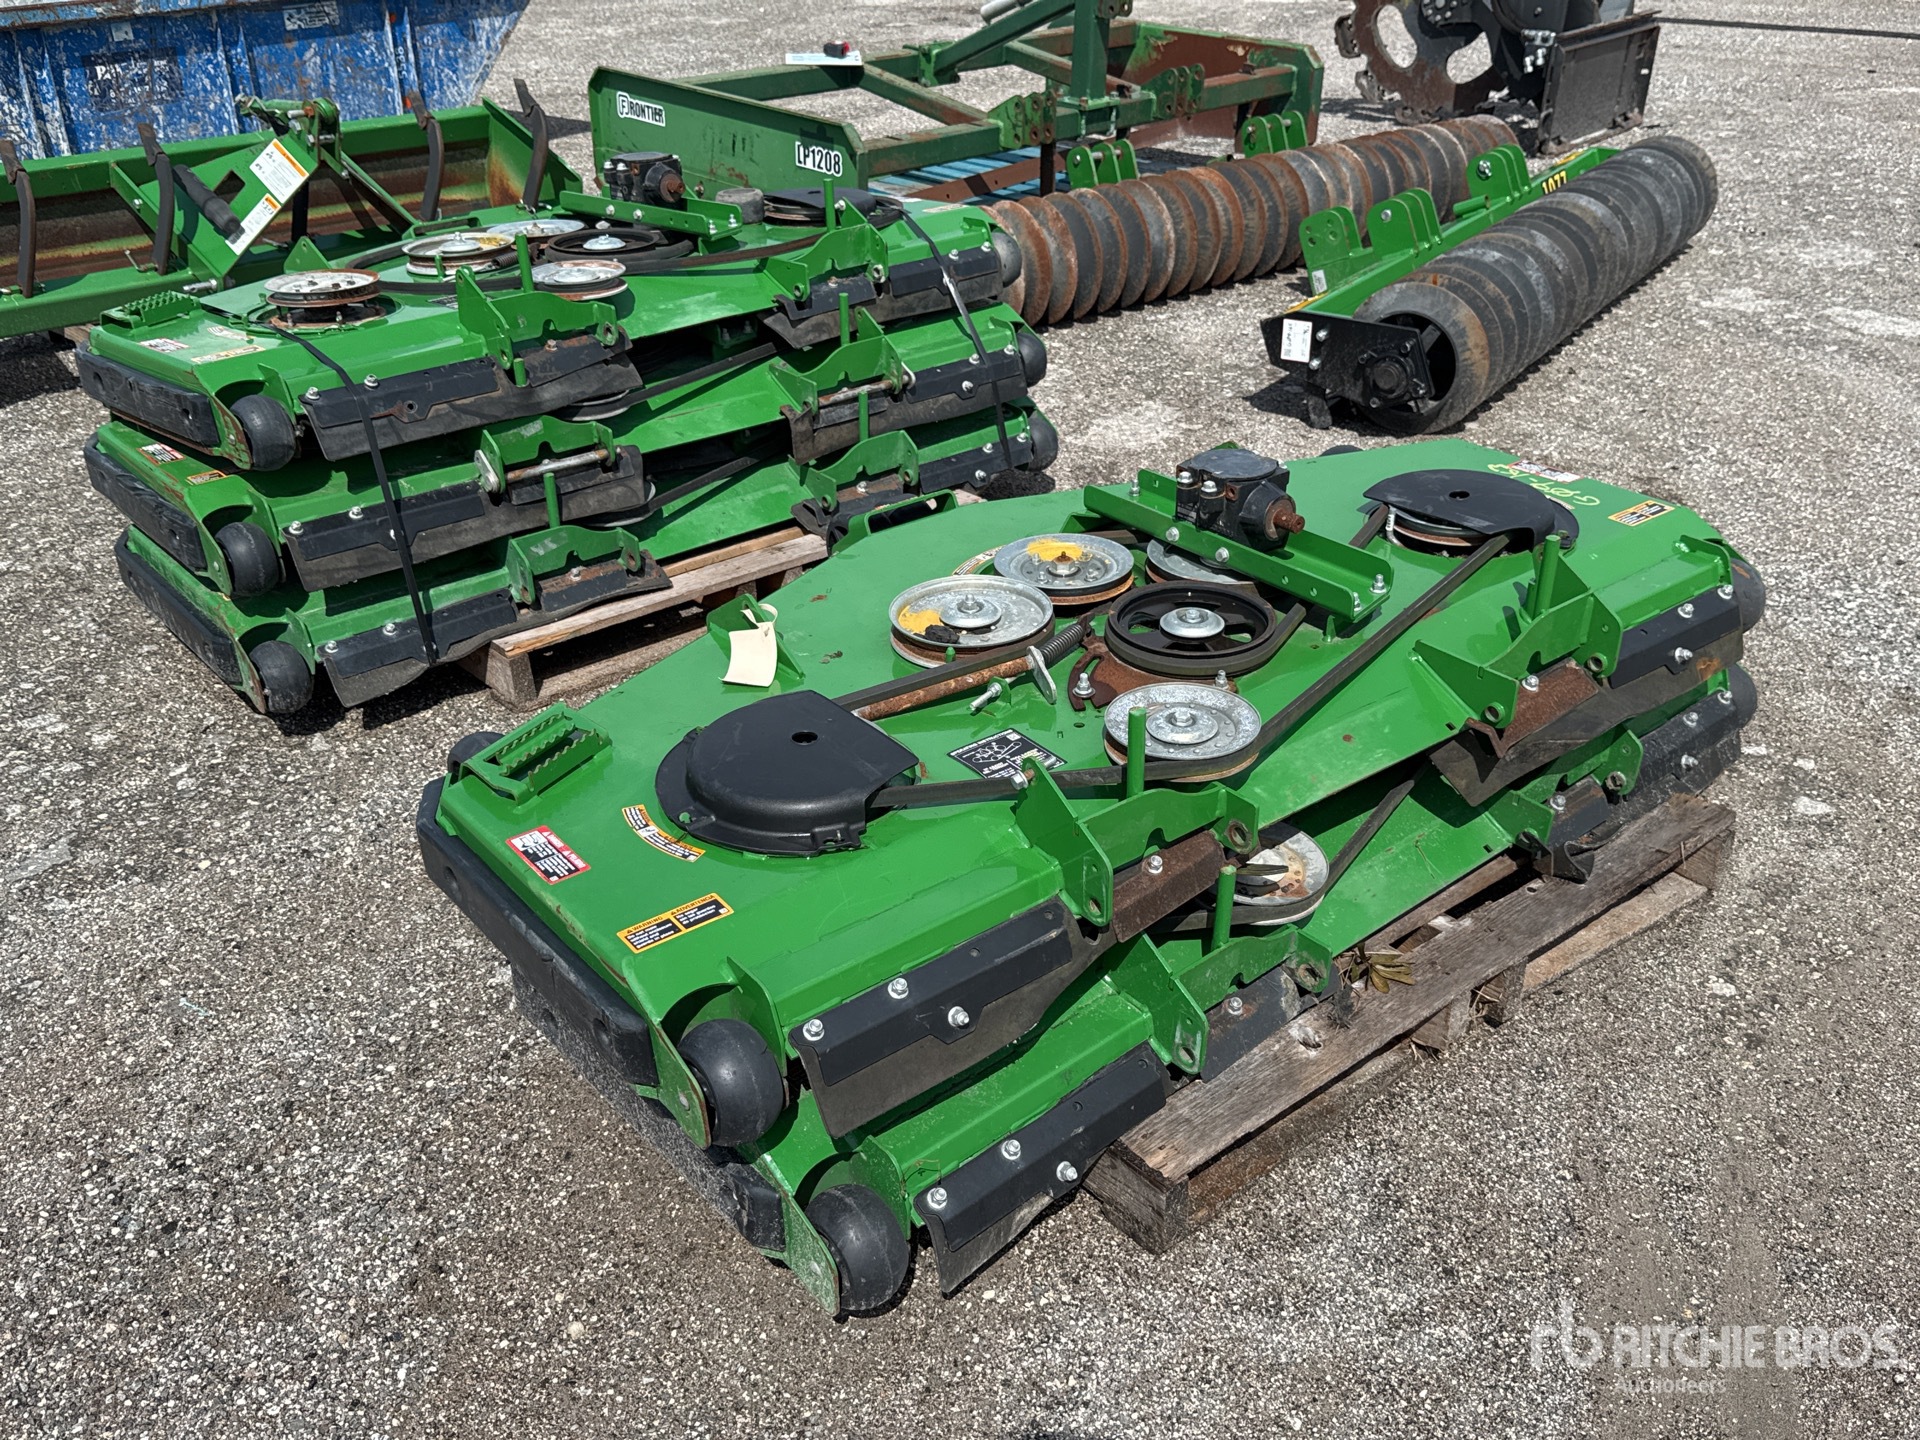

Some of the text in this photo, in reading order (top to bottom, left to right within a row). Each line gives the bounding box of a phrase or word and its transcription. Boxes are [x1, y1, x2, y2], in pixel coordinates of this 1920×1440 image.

[618, 93, 664, 124] FRONTIER
[797, 143, 842, 175] LP1208
[1541, 169, 1568, 195] 1077
[632, 915, 663, 931] WARNING
